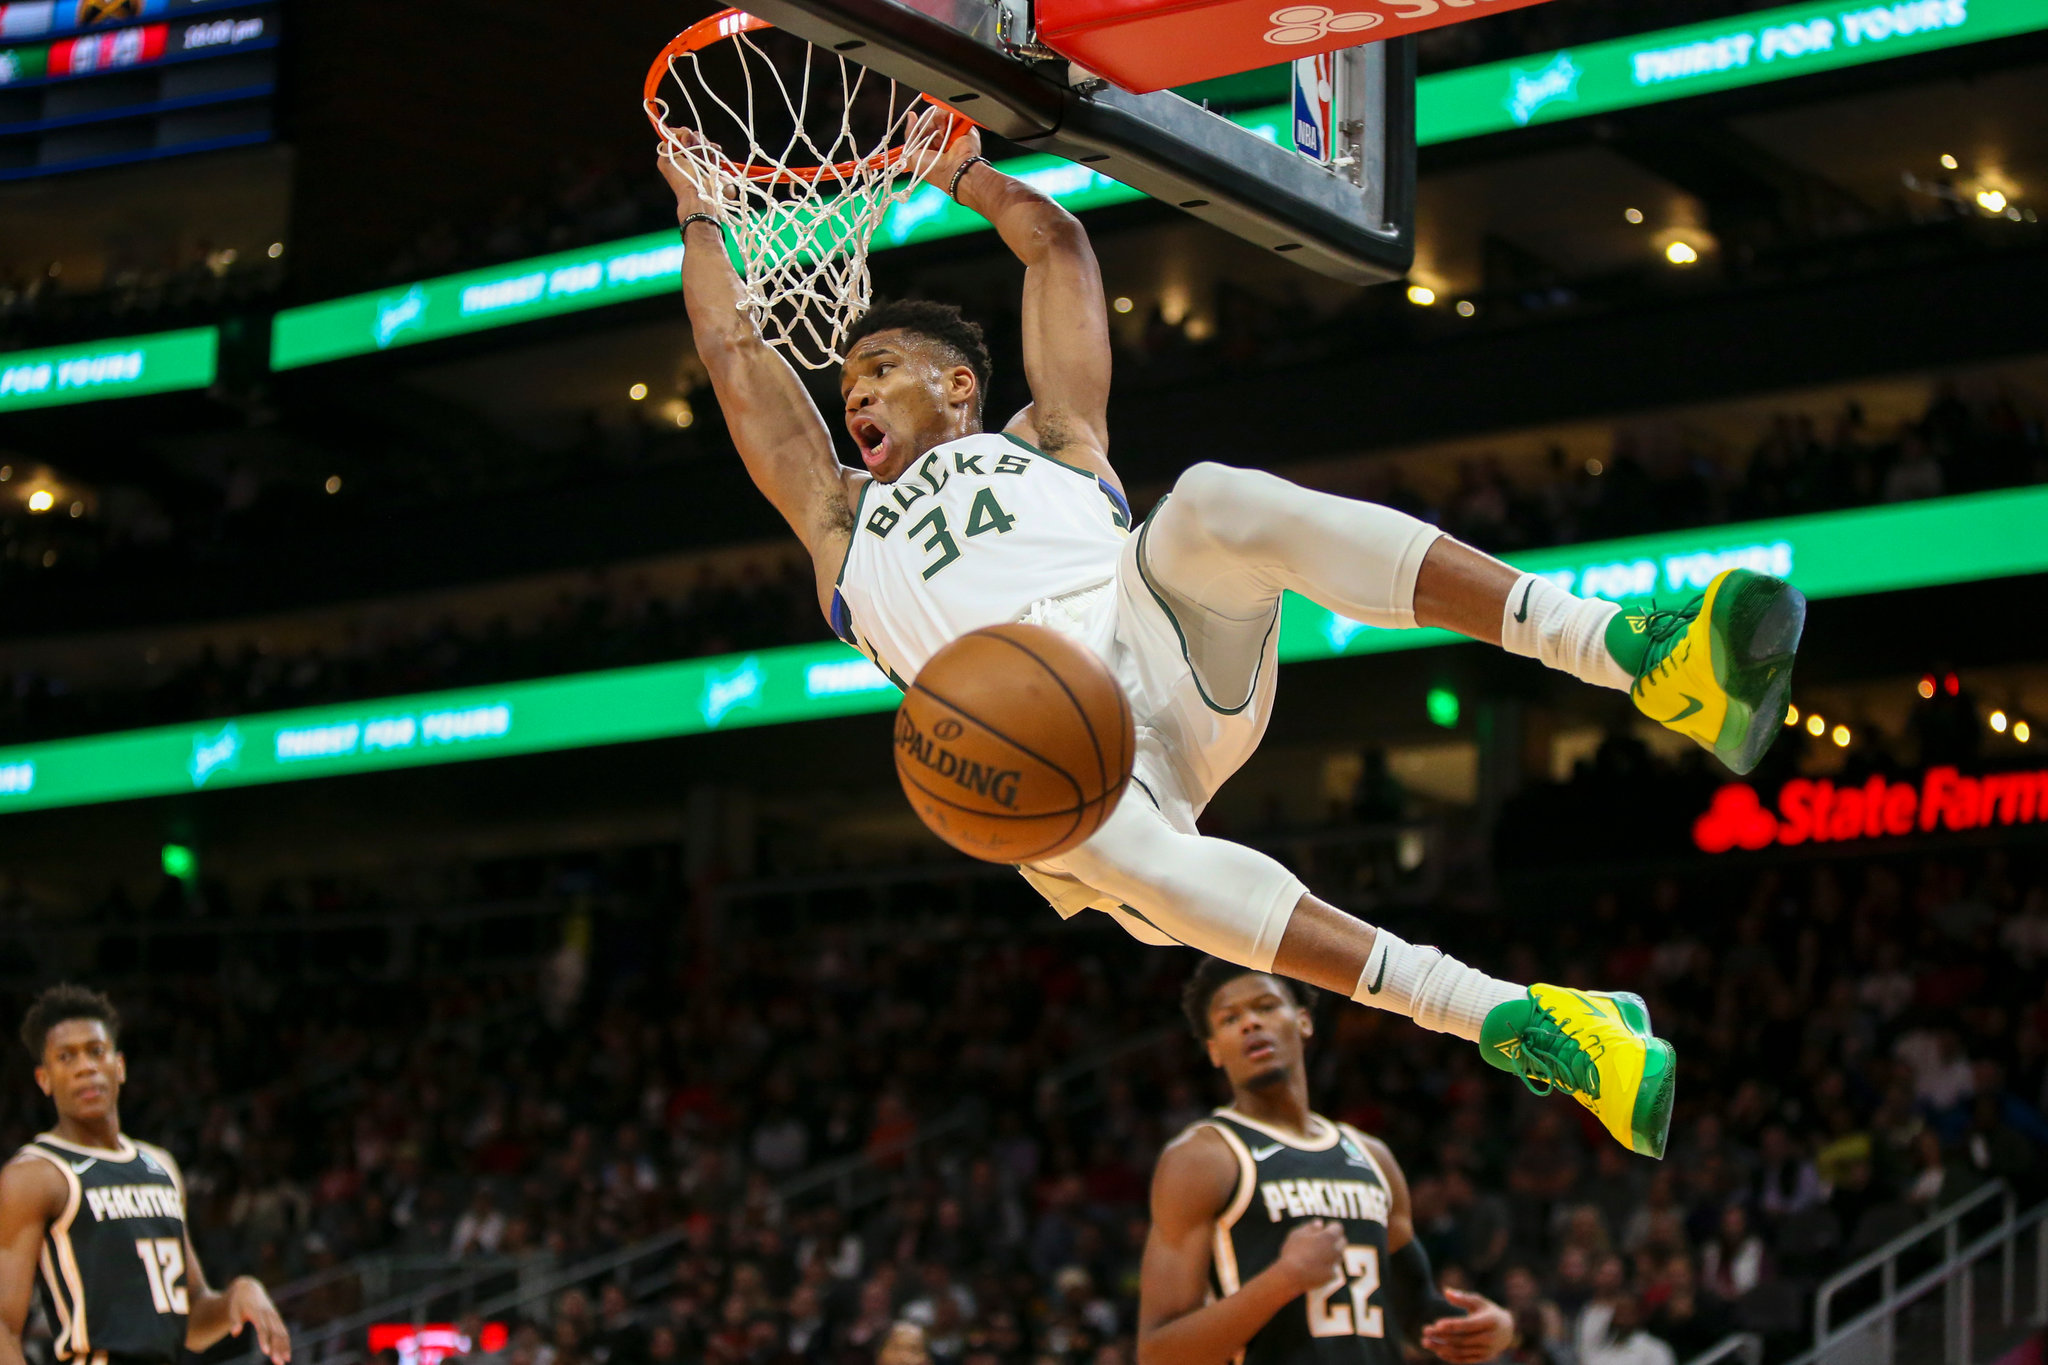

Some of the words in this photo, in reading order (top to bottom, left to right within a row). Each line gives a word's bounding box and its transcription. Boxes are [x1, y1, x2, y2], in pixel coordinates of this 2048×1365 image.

[1631, 32, 1756, 86] THIRST
[1759, 17, 1836, 62] FOR
[1841, 0, 1967, 46] YOURS
[1296, 119, 1318, 151] NBA
[606, 243, 685, 287] YOUR
[865, 450, 1033, 541] BUCKS
[906, 486, 1018, 583] 34
[1776, 773, 1918, 846] State
[1918, 764, 2048, 833] Farm
[135, 1237, 190, 1316] 12
[1305, 1244, 1385, 1339] 22
